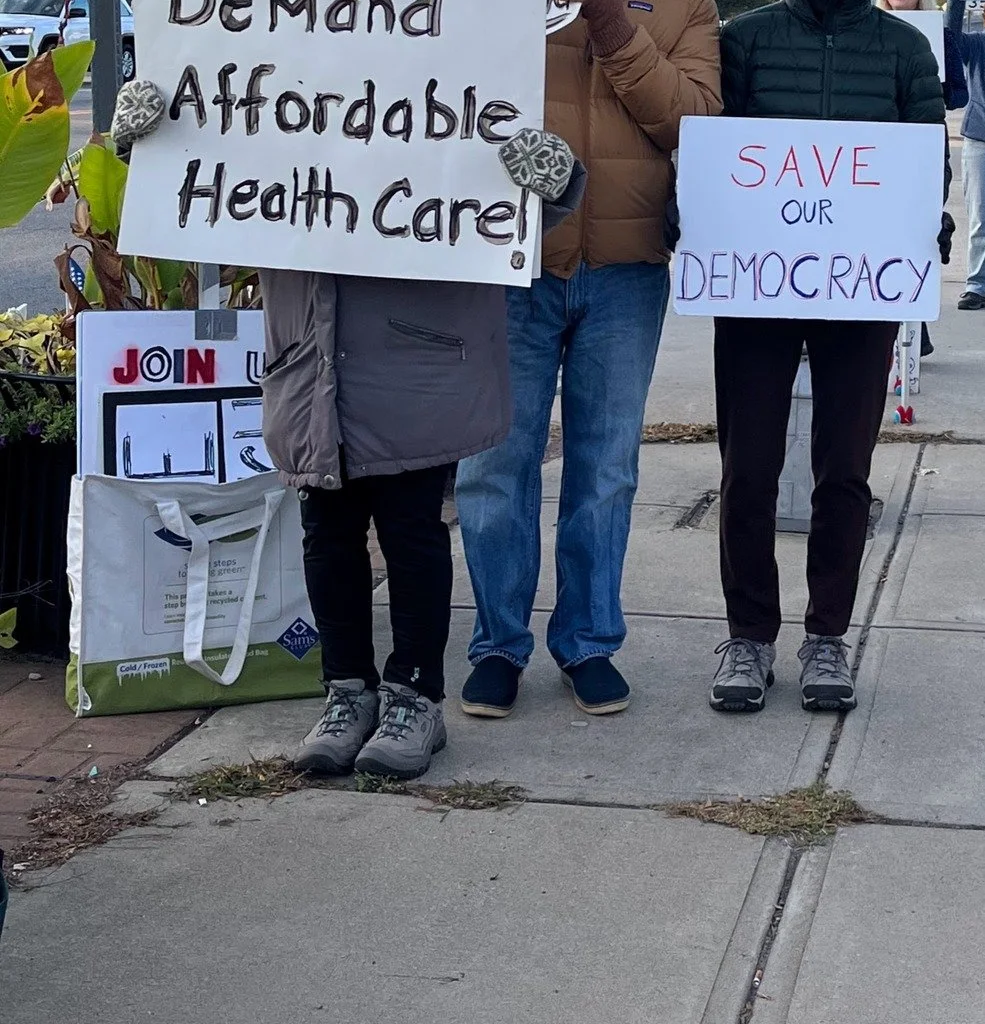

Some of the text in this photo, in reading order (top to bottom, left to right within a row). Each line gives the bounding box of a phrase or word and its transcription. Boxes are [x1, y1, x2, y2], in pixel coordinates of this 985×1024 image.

[168, 62, 523, 145] Affordable
[731, 144, 881, 189] SAVE
[178, 158, 527, 271] Health Care!
[781, 198, 833, 226] OUR
[675, 251, 932, 303] DEMOCRACY
[113, 345, 266, 385] JOIN U
[213, 558, 237, 568] steps
[163, 602, 179, 610] step
[209, 596, 239, 606] recycled
[164, 593, 179, 601] This
[119, 663, 137, 673] Cold
[143, 660, 168, 670] Frozen
